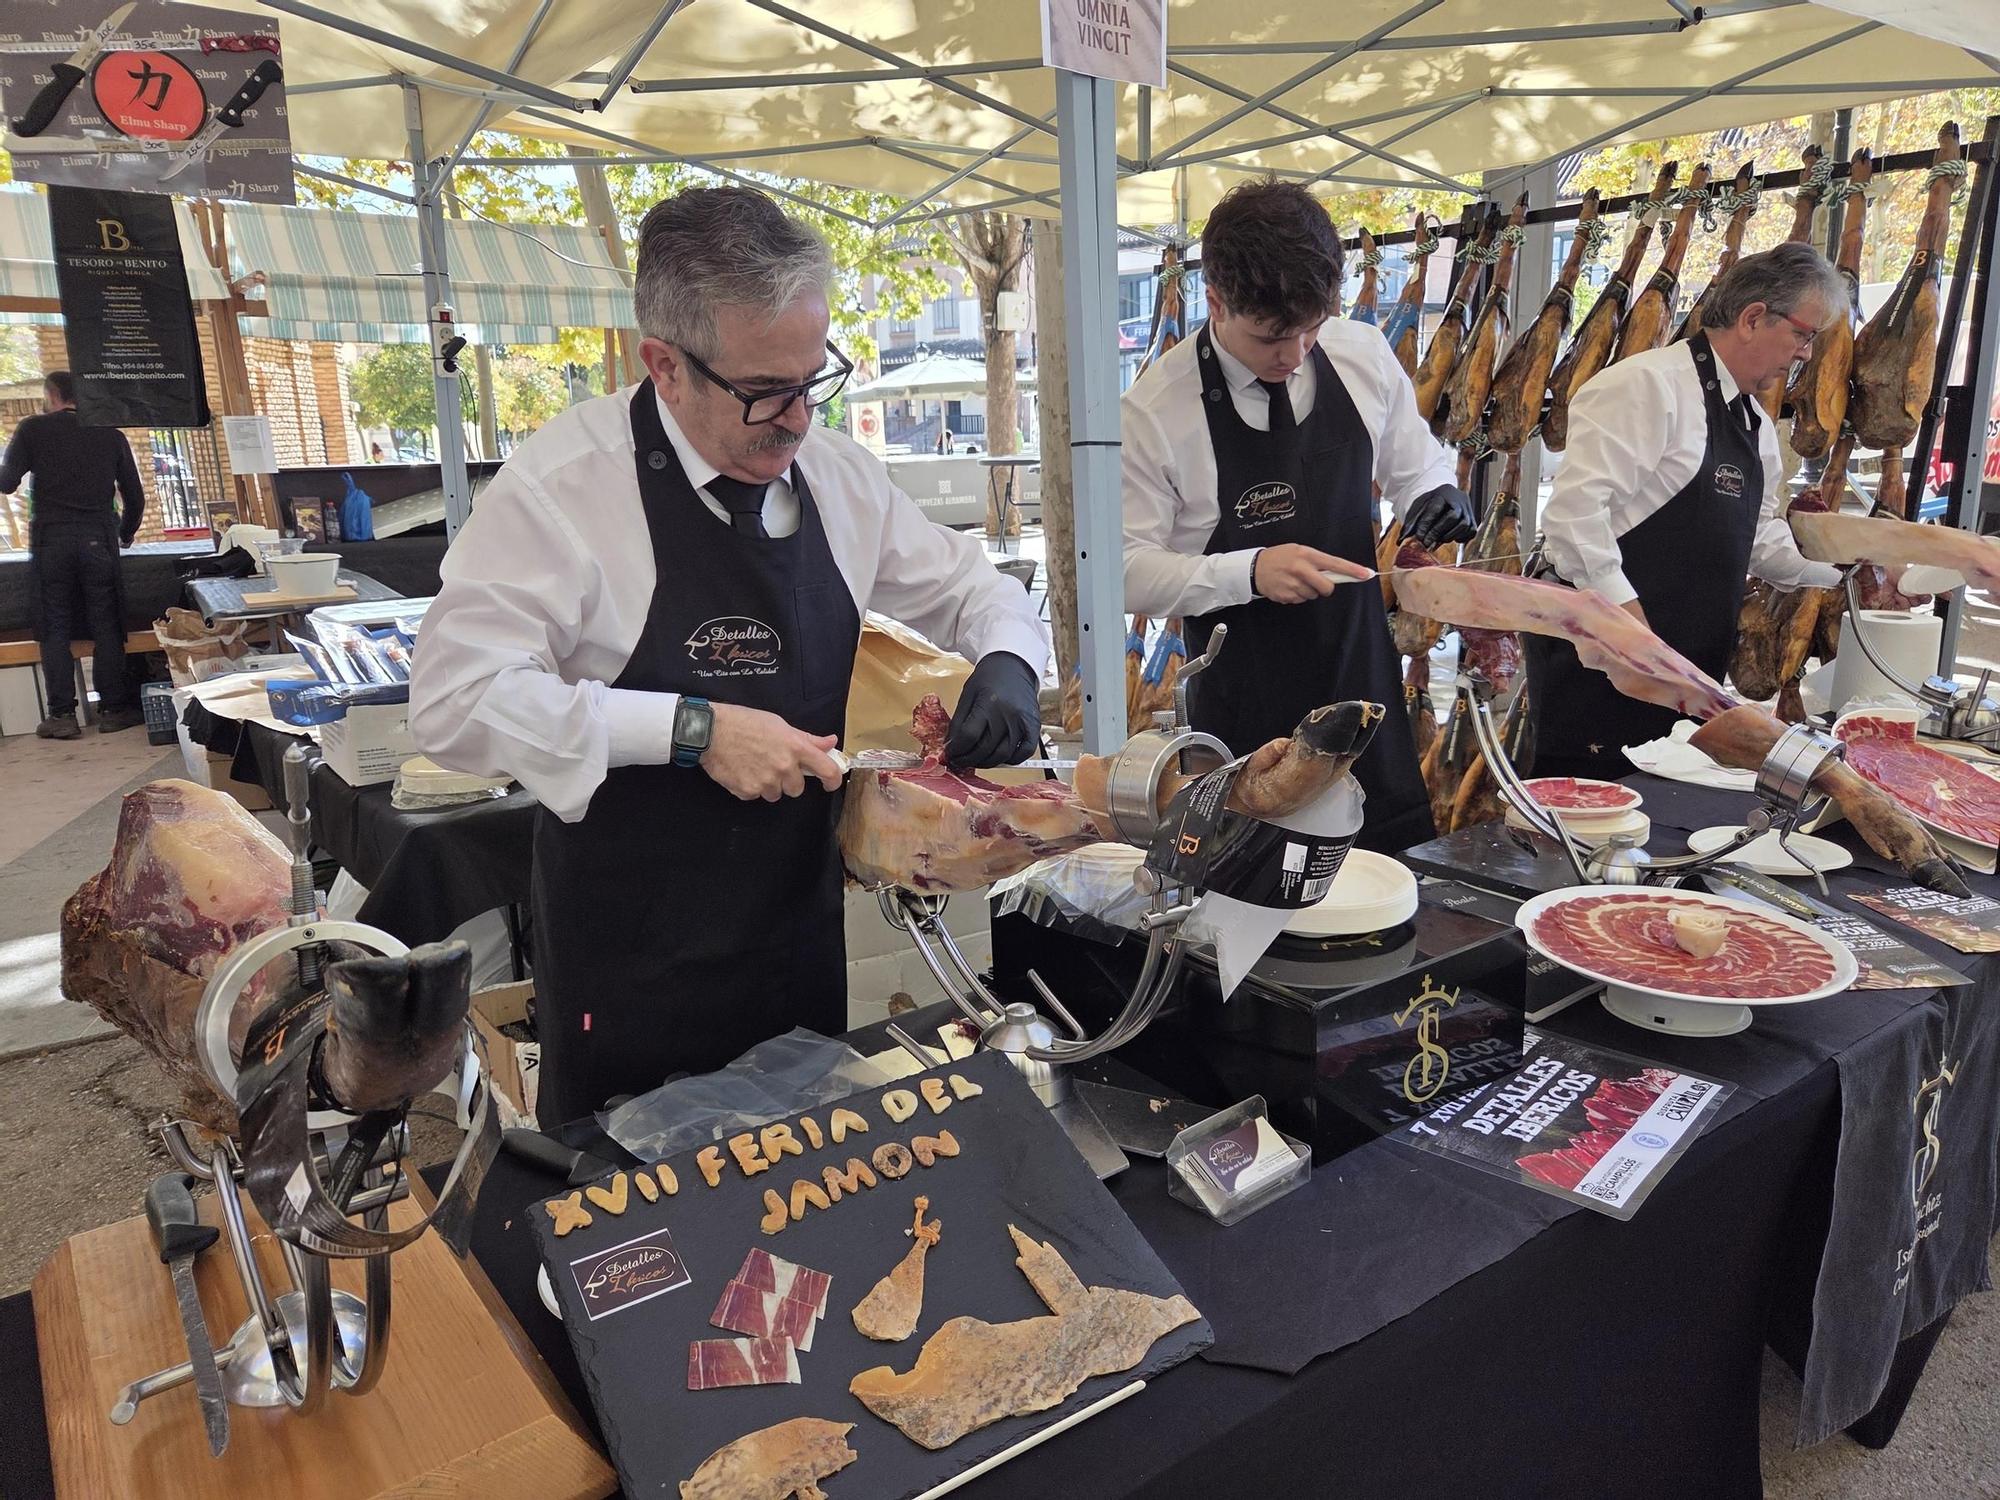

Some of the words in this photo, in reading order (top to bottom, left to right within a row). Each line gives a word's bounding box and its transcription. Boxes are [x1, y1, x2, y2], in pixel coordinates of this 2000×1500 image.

[1076, 0, 1131, 29] OMNIA
[41, 31, 76, 42] Elmu
[1077, 21, 1132, 56] VINCIT
[194, 69, 228, 80] Sharp
[69, 114, 101, 126] Elmu
[120, 115, 150, 128] Elmu
[153, 119, 188, 133] Sharp
[11, 156, 40, 169] harp
[61, 156, 92, 167] Elmu
[200, 187, 229, 198] Elmu
[248, 183, 280, 194] Sharp
[96, 218, 130, 251] B
[67, 258, 114, 268] TESORO
[124, 260, 168, 269] BENITO
[83, 371, 185, 381] www.ibericosbenito.com
[1249, 486, 1291, 502] Detalles
[710, 625, 772, 642] Detalles
[1179, 832, 1201, 855] B
[1462, 1055, 1566, 1136] DETALLES
[1501, 1069, 1597, 1143] IBERICOS
[1408, 1120, 1440, 1136] 7
[545, 1163, 679, 1237] XVII
[696, 1107, 870, 1187] FERIA
[880, 1073, 984, 1123] DEL
[760, 1128, 961, 1236] JAMON
[1605, 1158, 1637, 1190] CAMPILLOS
[605, 1250, 664, 1277] Detalles
